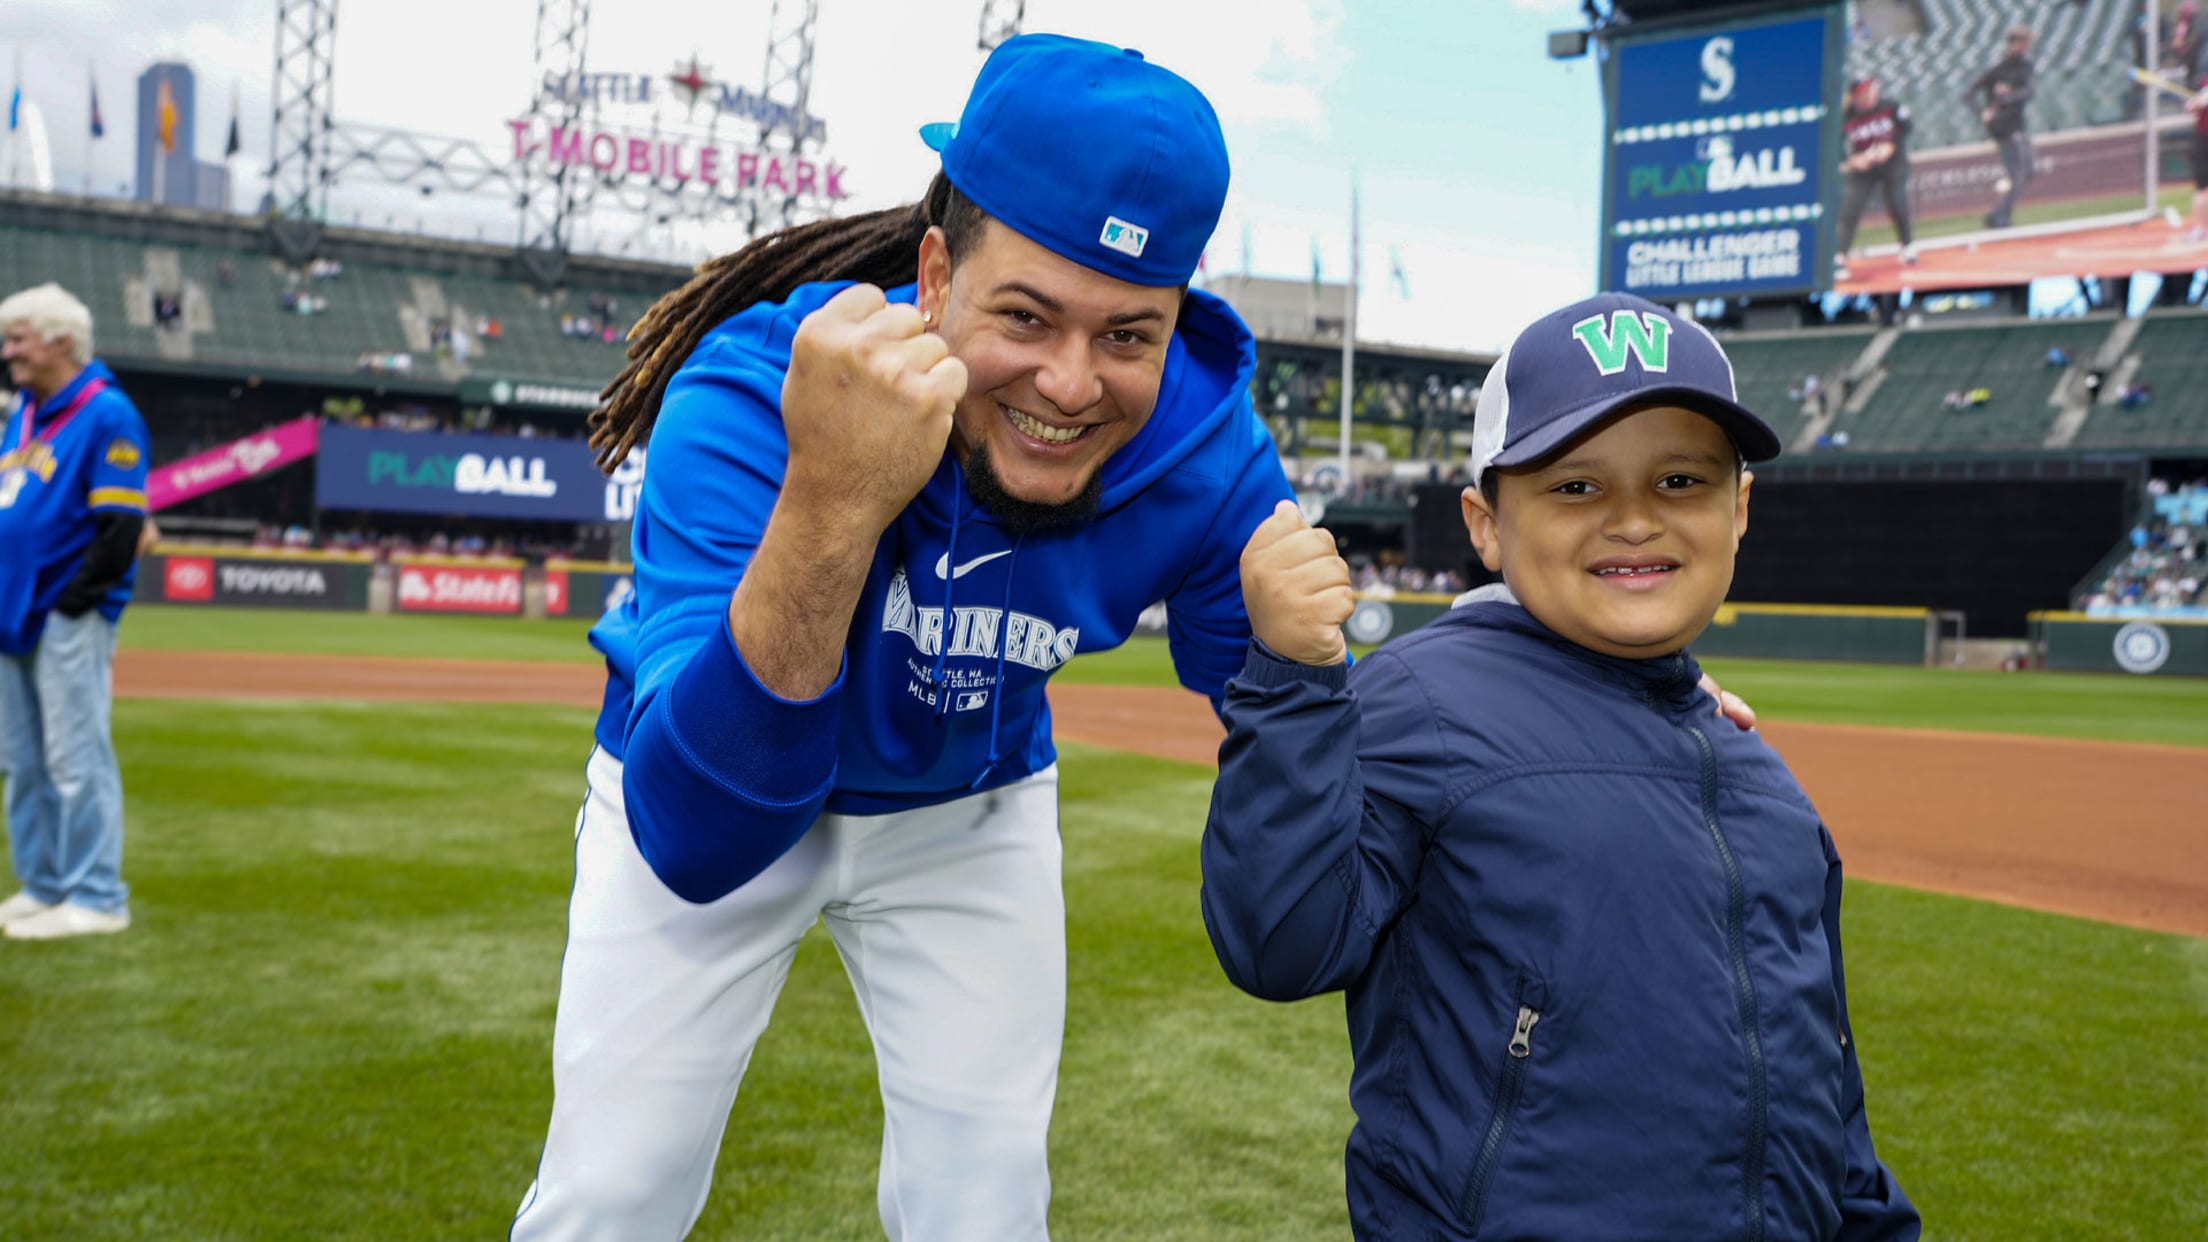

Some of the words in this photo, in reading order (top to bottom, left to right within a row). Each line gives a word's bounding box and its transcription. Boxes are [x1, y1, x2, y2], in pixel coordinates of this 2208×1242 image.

[507, 121, 720, 187] T-MOBILE
[738, 154, 848, 200] PARK
[1628, 229, 1799, 267] CHALLENGER
[1573, 310, 1673, 376] W
[220, 565, 326, 594] TOYOTA
[907, 657, 948, 689] AUTHENC
[951, 675, 1005, 688] COLLECTI
[907, 679, 937, 706] MLB
